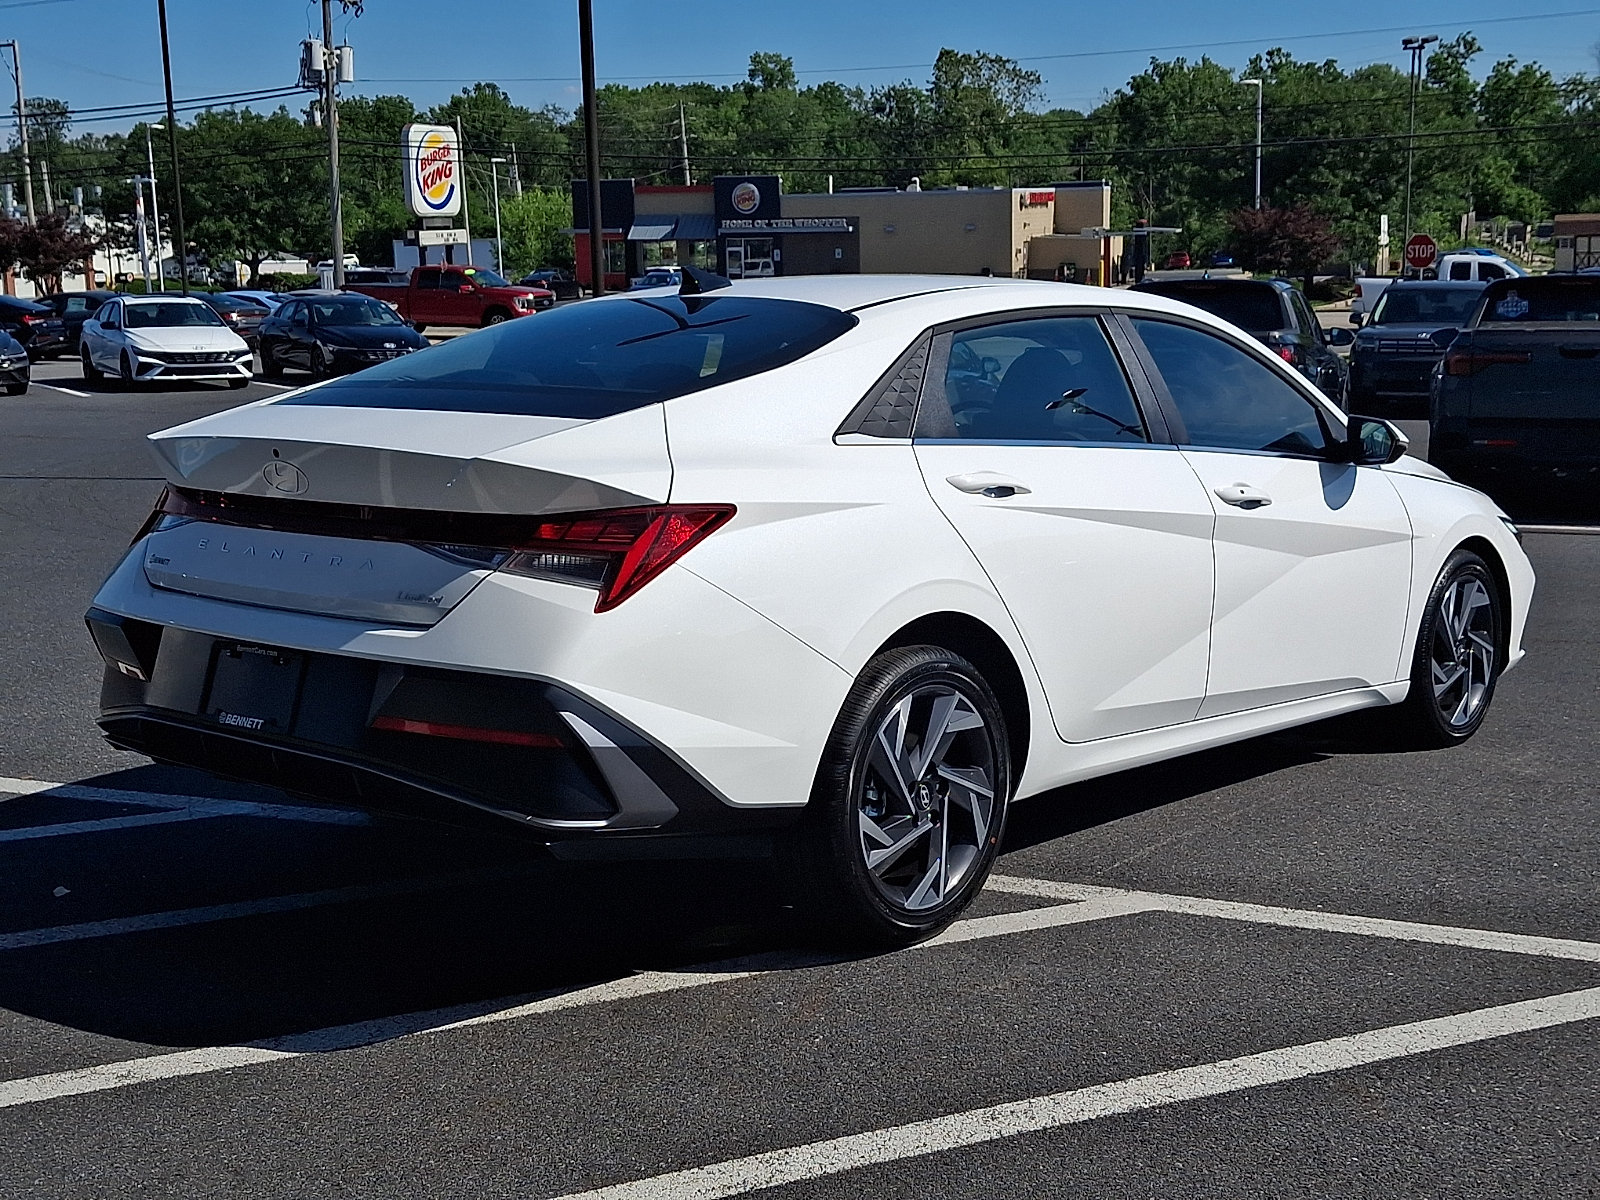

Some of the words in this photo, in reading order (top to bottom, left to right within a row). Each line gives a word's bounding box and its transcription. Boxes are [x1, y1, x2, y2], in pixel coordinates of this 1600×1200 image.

[421, 144, 451, 172] BURGER
[422, 160, 453, 195] KING
[722, 219, 752, 228] HOME
[754, 219, 769, 228] OF
[770, 219, 793, 228] THE
[794, 218, 847, 228] WHOPPER
[1407, 244, 1434, 258] STOP
[198, 538, 374, 570] ELANTRA
[225, 713, 265, 730] BENNETT
